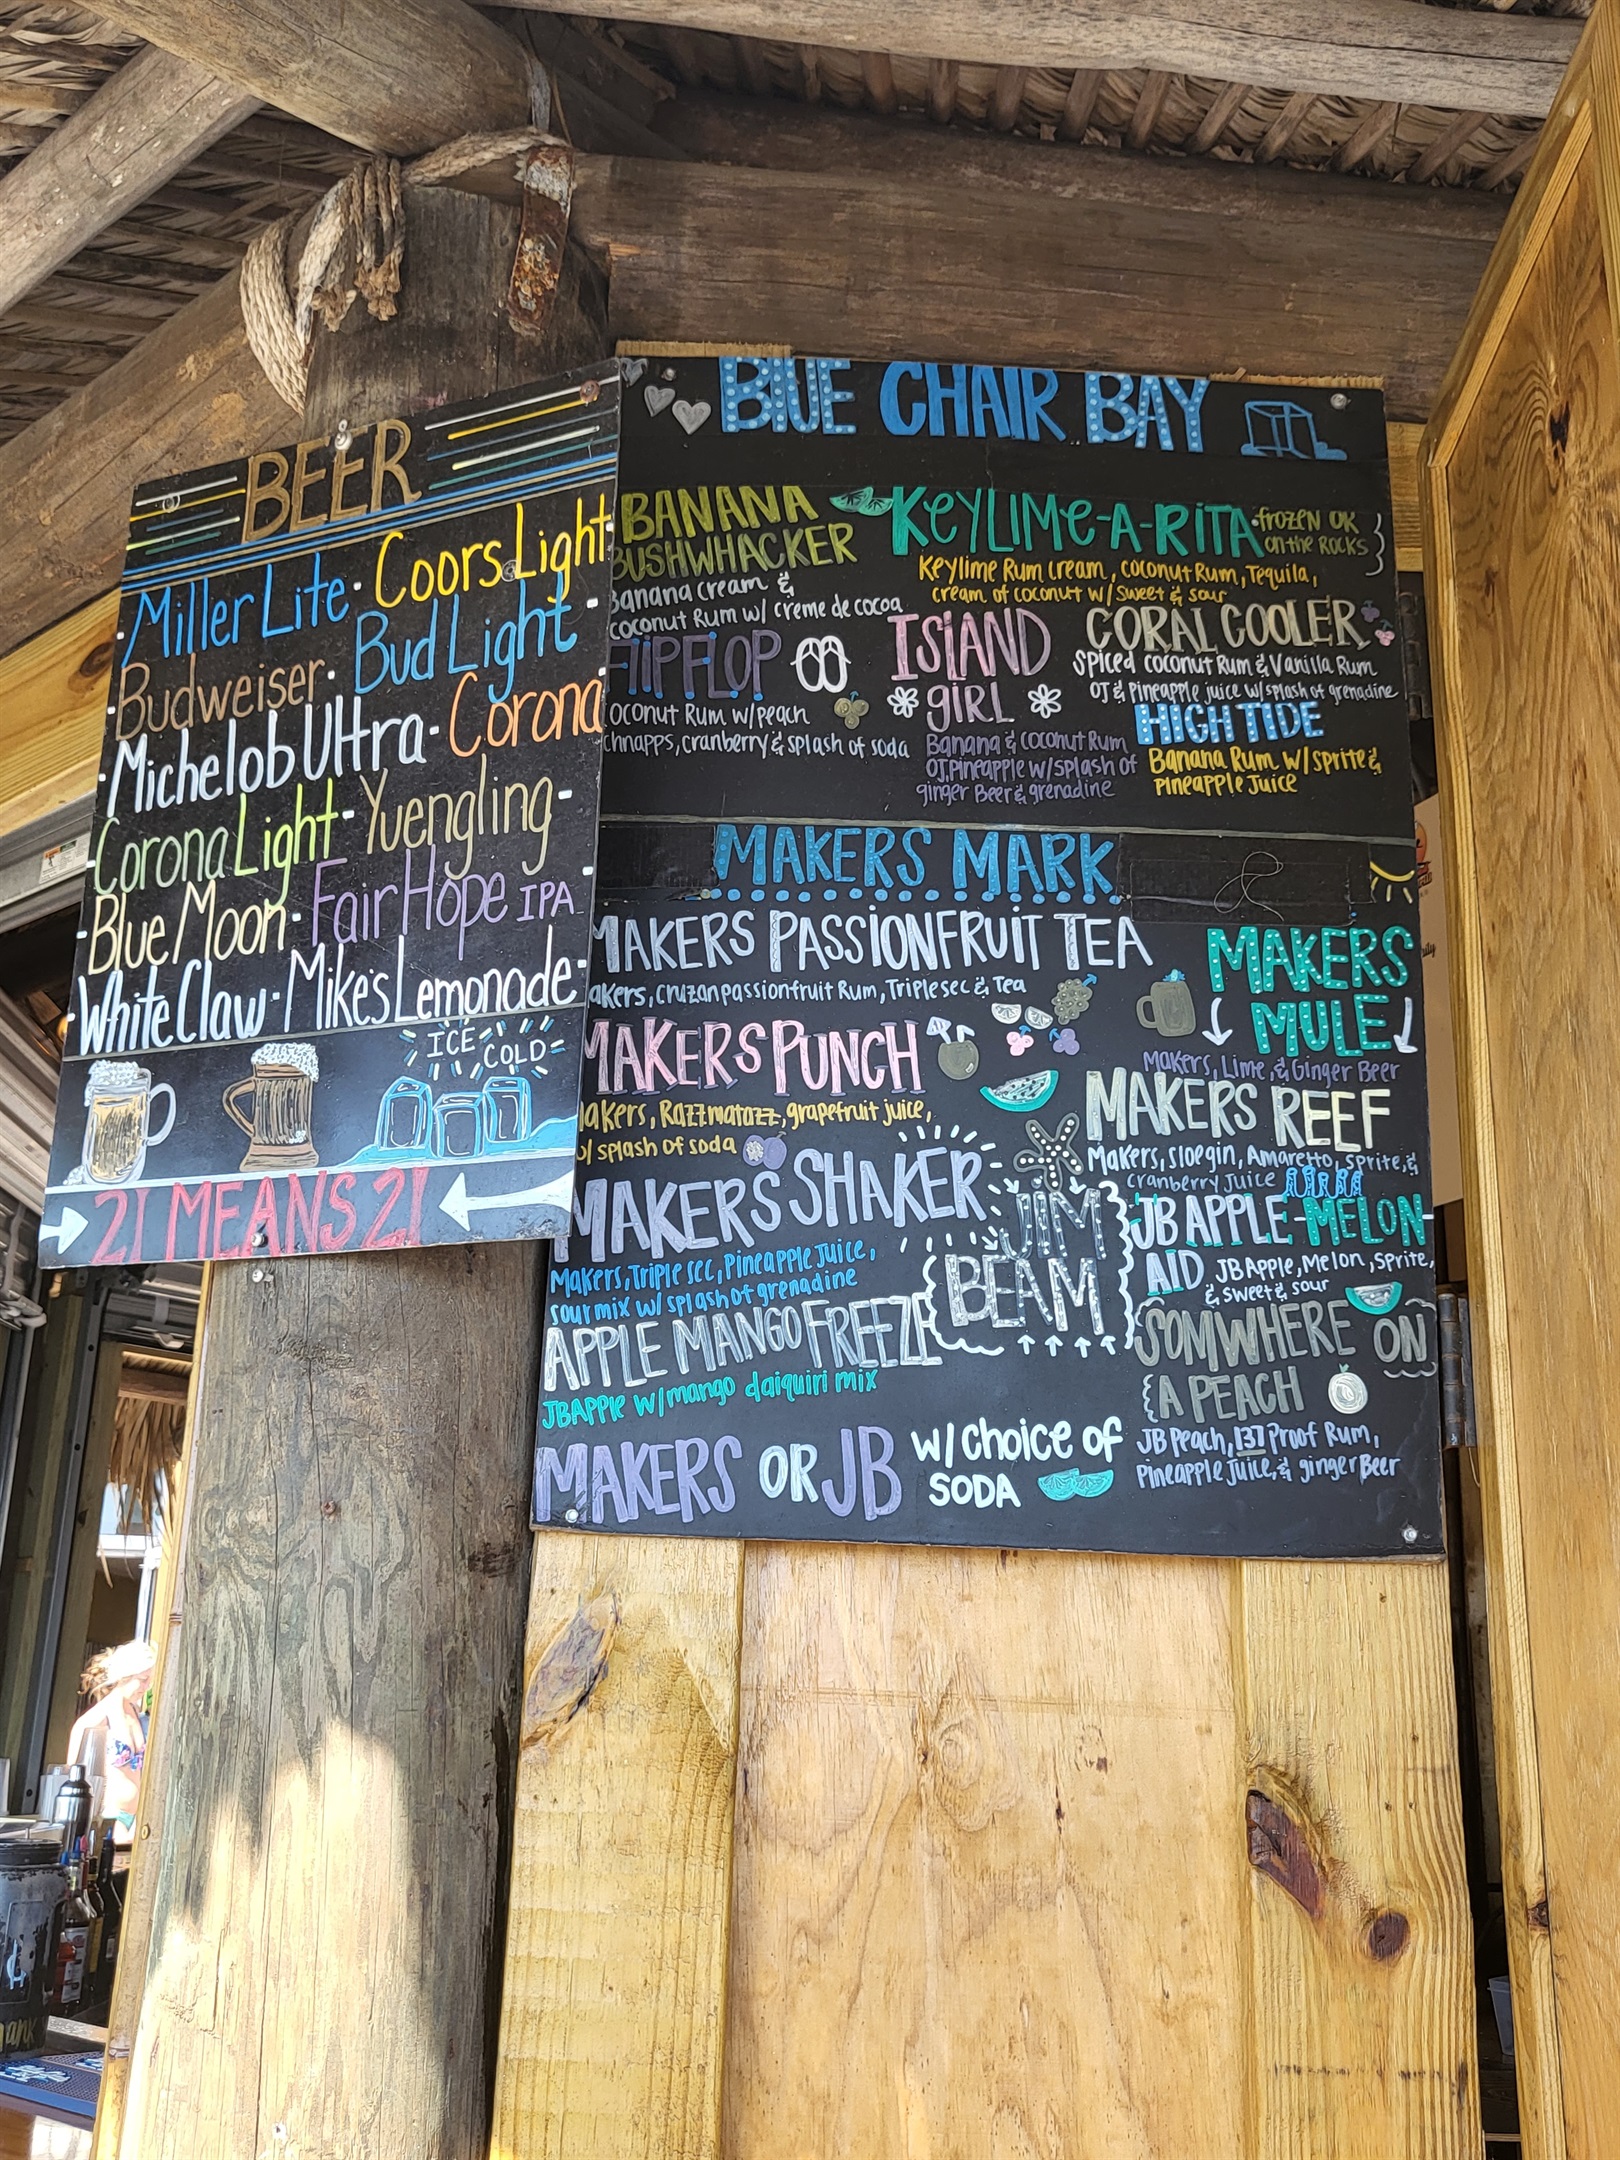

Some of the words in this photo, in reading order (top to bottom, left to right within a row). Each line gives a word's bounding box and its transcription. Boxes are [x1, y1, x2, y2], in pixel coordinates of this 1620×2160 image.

[879, 361, 1067, 441] CHAIR
[1085, 372, 1210, 453] BAY
[241, 419, 422, 545] BEER
[621, 485, 819, 544] BANANA
[121, 577, 254, 668] Miller
[375, 531, 502, 609] Coors
[514, 493, 612, 603] Light
[612, 523, 858, 582] BUSHWHACKER
[1003, 558, 1043, 582] Rum
[693, 607, 739, 628] Rum
[774, 599, 827, 620] creme
[831, 594, 851, 618] de
[854, 597, 904, 616] cocoa
[697, 575, 768, 601] cream
[777, 571, 794, 598] &
[993, 585, 1010, 602] of
[1189, 588, 1227, 604] sour
[887, 608, 1051, 681] ISLAND
[1086, 606, 1218, 654] CORAL
[1220, 595, 1371, 650] COOLER
[116, 653, 327, 741] Budweiser
[355, 597, 439, 694] Bud
[448, 570, 578, 704] Light
[1216, 655, 1253, 677] Rum
[1336, 656, 1377, 677] Rum
[685, 704, 727, 726] Rum
[1134, 702, 1234, 745] HIGH
[1235, 701, 1324, 744] TIDE
[1329, 683, 1399, 706] grenadine
[108, 708, 296, 817] Michelob
[304, 695, 427, 779] Ultra
[449, 671, 603, 757] Corona
[787, 732, 845, 756] splash
[849, 735, 866, 755] of
[872, 737, 910, 758] soda
[927, 733, 1000, 757] Banana
[1088, 730, 1129, 753] Rum
[1148, 747, 1224, 776] Banana
[1229, 750, 1280, 773] Rum
[974, 784, 1012, 804] Beer
[1029, 780, 1116, 805] grenadine
[94, 817, 227, 897] Corona
[235, 778, 339, 906] Light
[359, 754, 553, 879] Yuengling
[713, 824, 932, 889] MAKERS
[953, 827, 1119, 895] MARK
[88, 892, 170, 975] Blue
[173, 878, 288, 968] Moon
[515, 880, 575, 922] IPA
[592, 910, 755, 973] MAKERS
[1053, 911, 1154, 970] TEA
[993, 976, 1026, 996] Tea
[1207, 926, 1415, 994] MAKERS
[78, 965, 174, 1057] White
[176, 959, 267, 1041] Claw
[394, 924, 578, 1024] Lemonade
[427, 1026, 476, 1058] ICE
[483, 1038, 547, 1068] COLD
[1251, 993, 1392, 1057] MULE
[584, 1016, 769, 1096] MAKERS
[772, 1020, 927, 1096] PUNCH
[1359, 1060, 1400, 1082] Beer
[1086, 1066, 1258, 1141] MAKERS
[1270, 1085, 1391, 1152] REEF
[597, 1136, 659, 1163] splash
[663, 1134, 684, 1156] of
[689, 1134, 737, 1156] soda
[164, 1171, 358, 1261] MEANS
[554, 1171, 785, 1263] MAKERS
[788, 1147, 988, 1227] SHAKER
[999, 1188, 1107, 1261] JIM
[551, 1304, 591, 1325] sour
[597, 1297, 630, 1320] mix
[758, 1268, 858, 1306] grenadine
[944, 1254, 1106, 1336] BEAM
[1146, 1249, 1205, 1297] AID
[1292, 1279, 1329, 1296] sour
[543, 1321, 668, 1391] APPLE
[672, 1305, 803, 1374] MANGO
[800, 1291, 943, 1368] FREEZE
[1135, 1300, 1357, 1373] SOMWHERE
[1374, 1313, 1428, 1364] ON
[744, 1370, 827, 1402] daiquiri
[835, 1368, 879, 1392] mix
[1159, 1375, 1185, 1419] A
[1188, 1365, 1305, 1423] PEACH
[1082, 1416, 1124, 1463] of
[534, 1436, 743, 1523] MAKERS
[759, 1443, 819, 1502] OR
[822, 1425, 903, 1521] JB
[928, 1472, 1022, 1509] SODA
